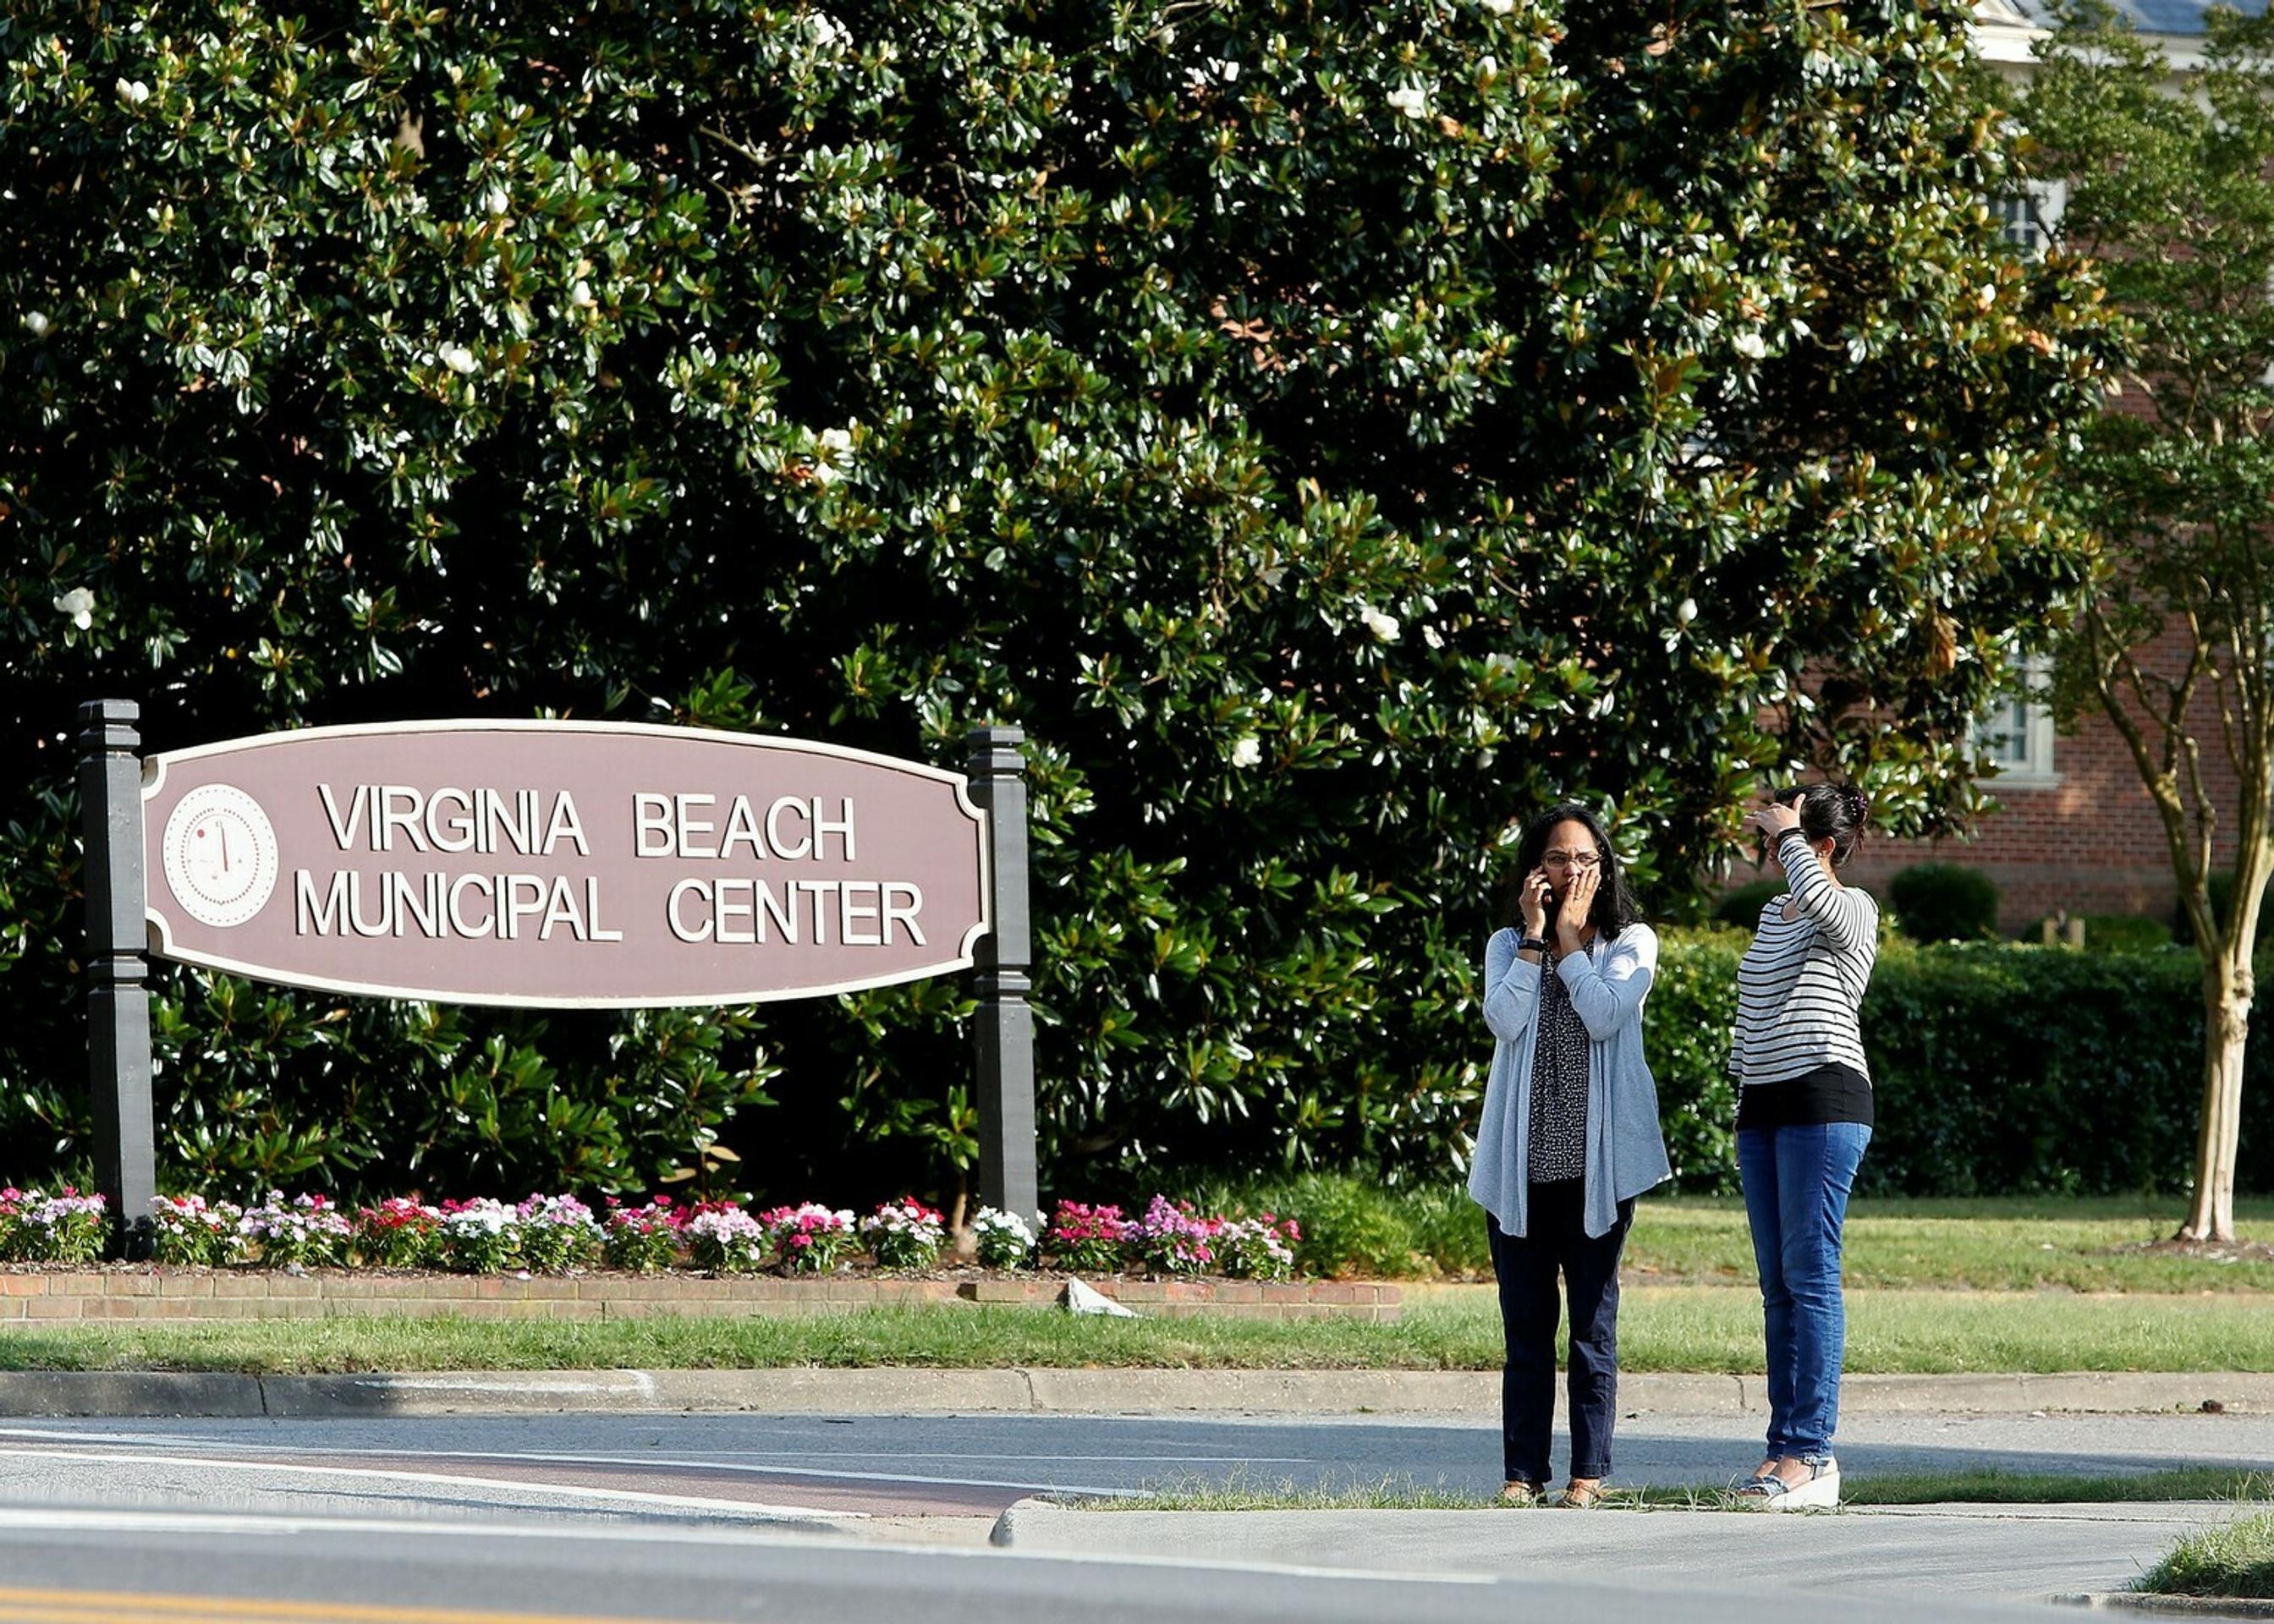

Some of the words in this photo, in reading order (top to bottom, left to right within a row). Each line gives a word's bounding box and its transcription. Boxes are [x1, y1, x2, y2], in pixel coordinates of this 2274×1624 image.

[317, 783, 590, 856] VIRGINIA
[634, 792, 856, 861] BEACH
[295, 870, 623, 942] MUNICIPAL
[667, 877, 927, 946] CENTER
